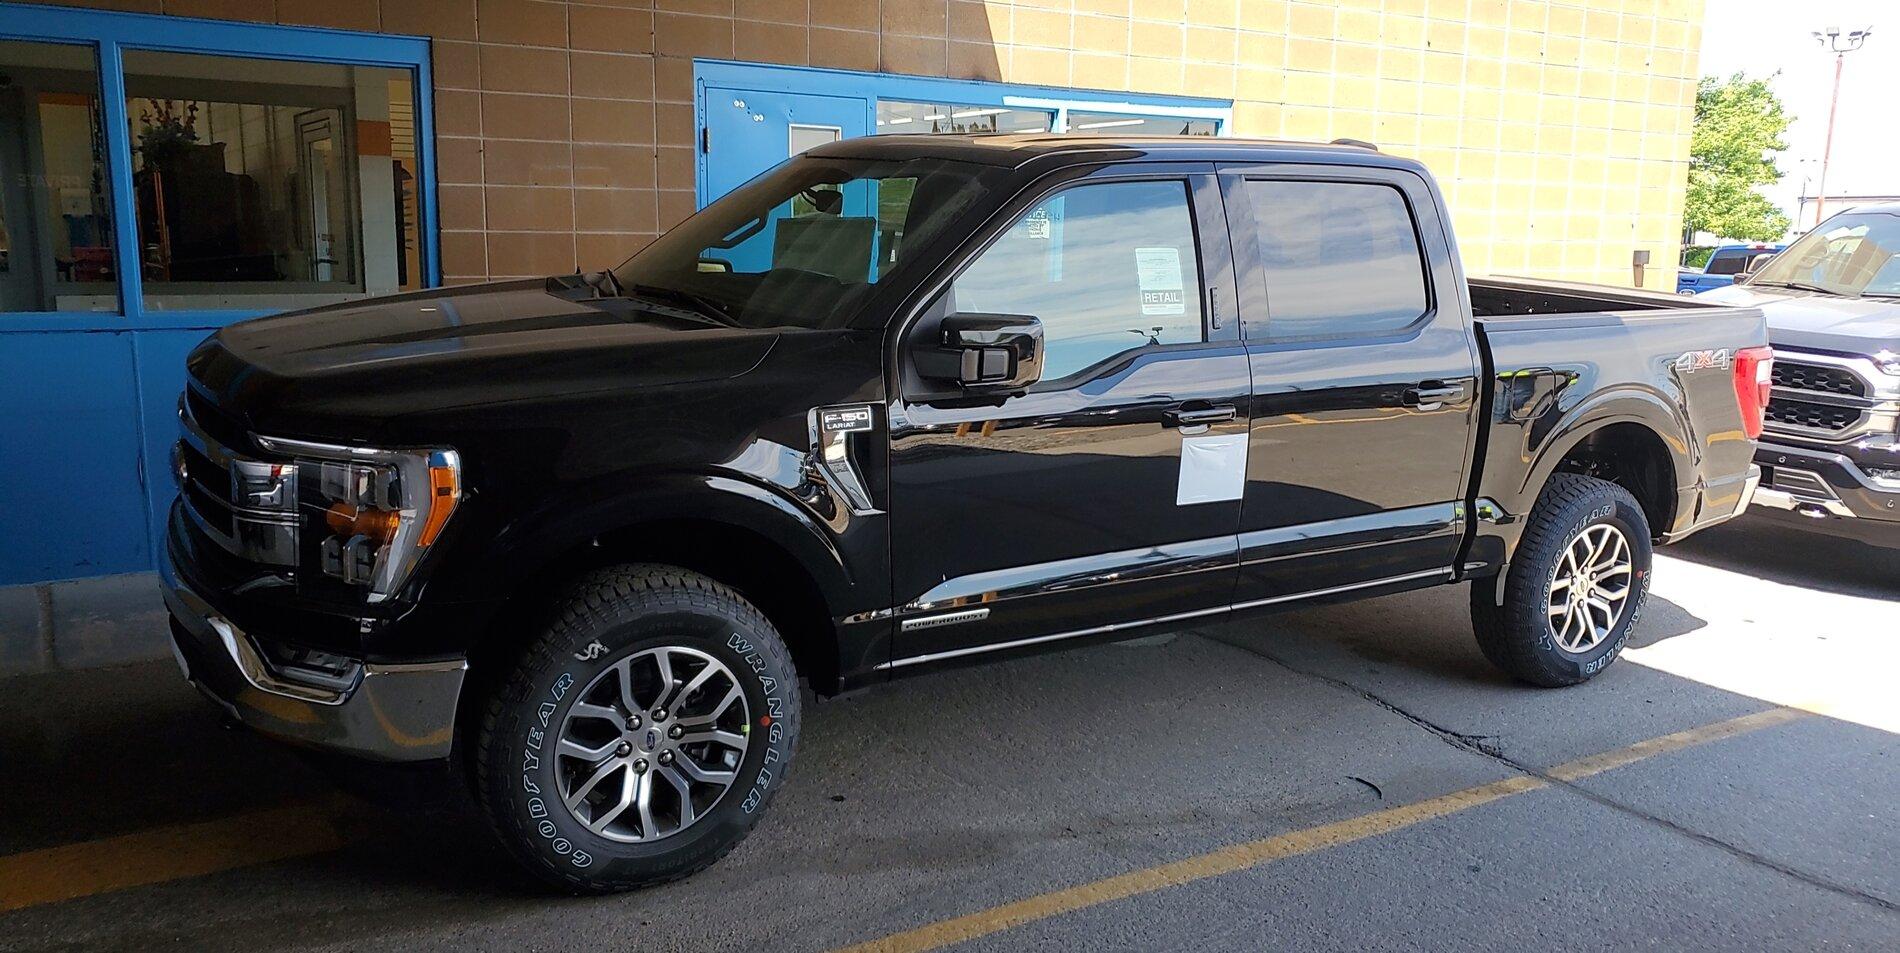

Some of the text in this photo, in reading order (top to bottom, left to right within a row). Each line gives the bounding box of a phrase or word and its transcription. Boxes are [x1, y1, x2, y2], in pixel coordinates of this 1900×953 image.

[1144, 292, 1181, 304] RETAIL
[824, 411, 869, 423] F-150
[826, 421, 856, 430] LARIAT
[1540, 505, 1611, 615] GOODYEAR
[1586, 570, 1651, 674] WRANGLER
[523, 672, 593, 868] GOODYEAR
[727, 632, 783, 814] WRANGLER
